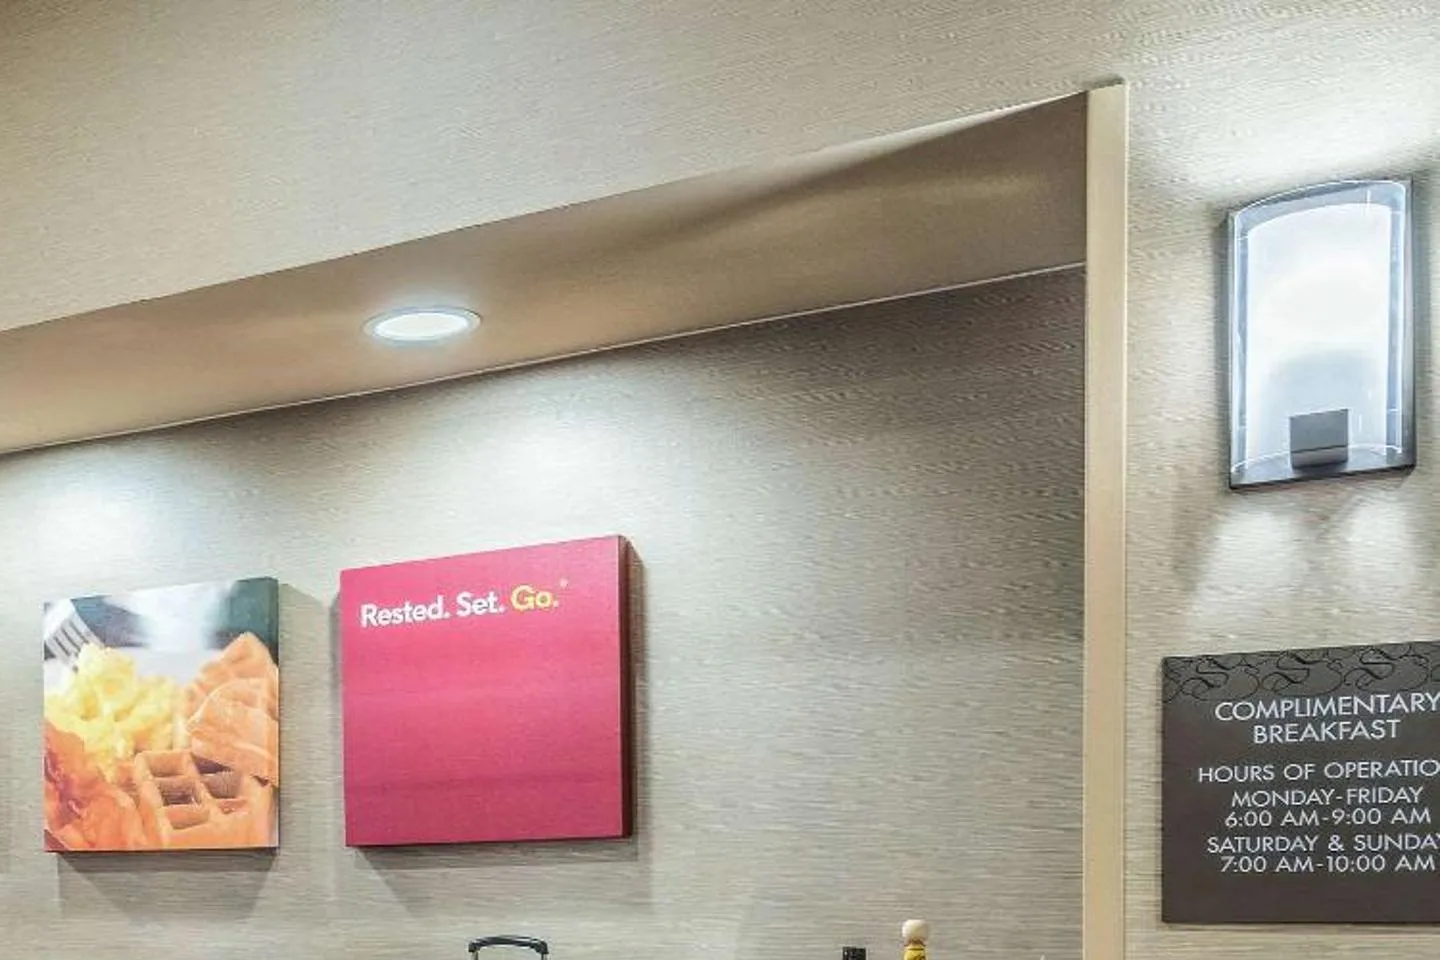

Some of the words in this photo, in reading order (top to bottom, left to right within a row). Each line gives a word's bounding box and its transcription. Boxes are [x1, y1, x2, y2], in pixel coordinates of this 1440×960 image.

[360, 593, 451, 628] Rested.
[456, 591, 506, 617] Set.
[511, 584, 559, 611] Go.
[1215, 692, 1440, 721] COMPLIMENTARY
[1253, 719, 1401, 744] BREAKFAST
[1198, 765, 1276, 783] HOURS
[1283, 763, 1315, 781] OF
[1225, 810, 1272, 827] 6:00
[1390, 807, 1432, 825] AM
[1207, 834, 1319, 854] SATURDAY
[1328, 834, 1344, 852] &
[1353, 832, 1440, 852] SUNDA
[1220, 856, 1266, 873] 7:00
[1394, 854, 1436, 871] AM
